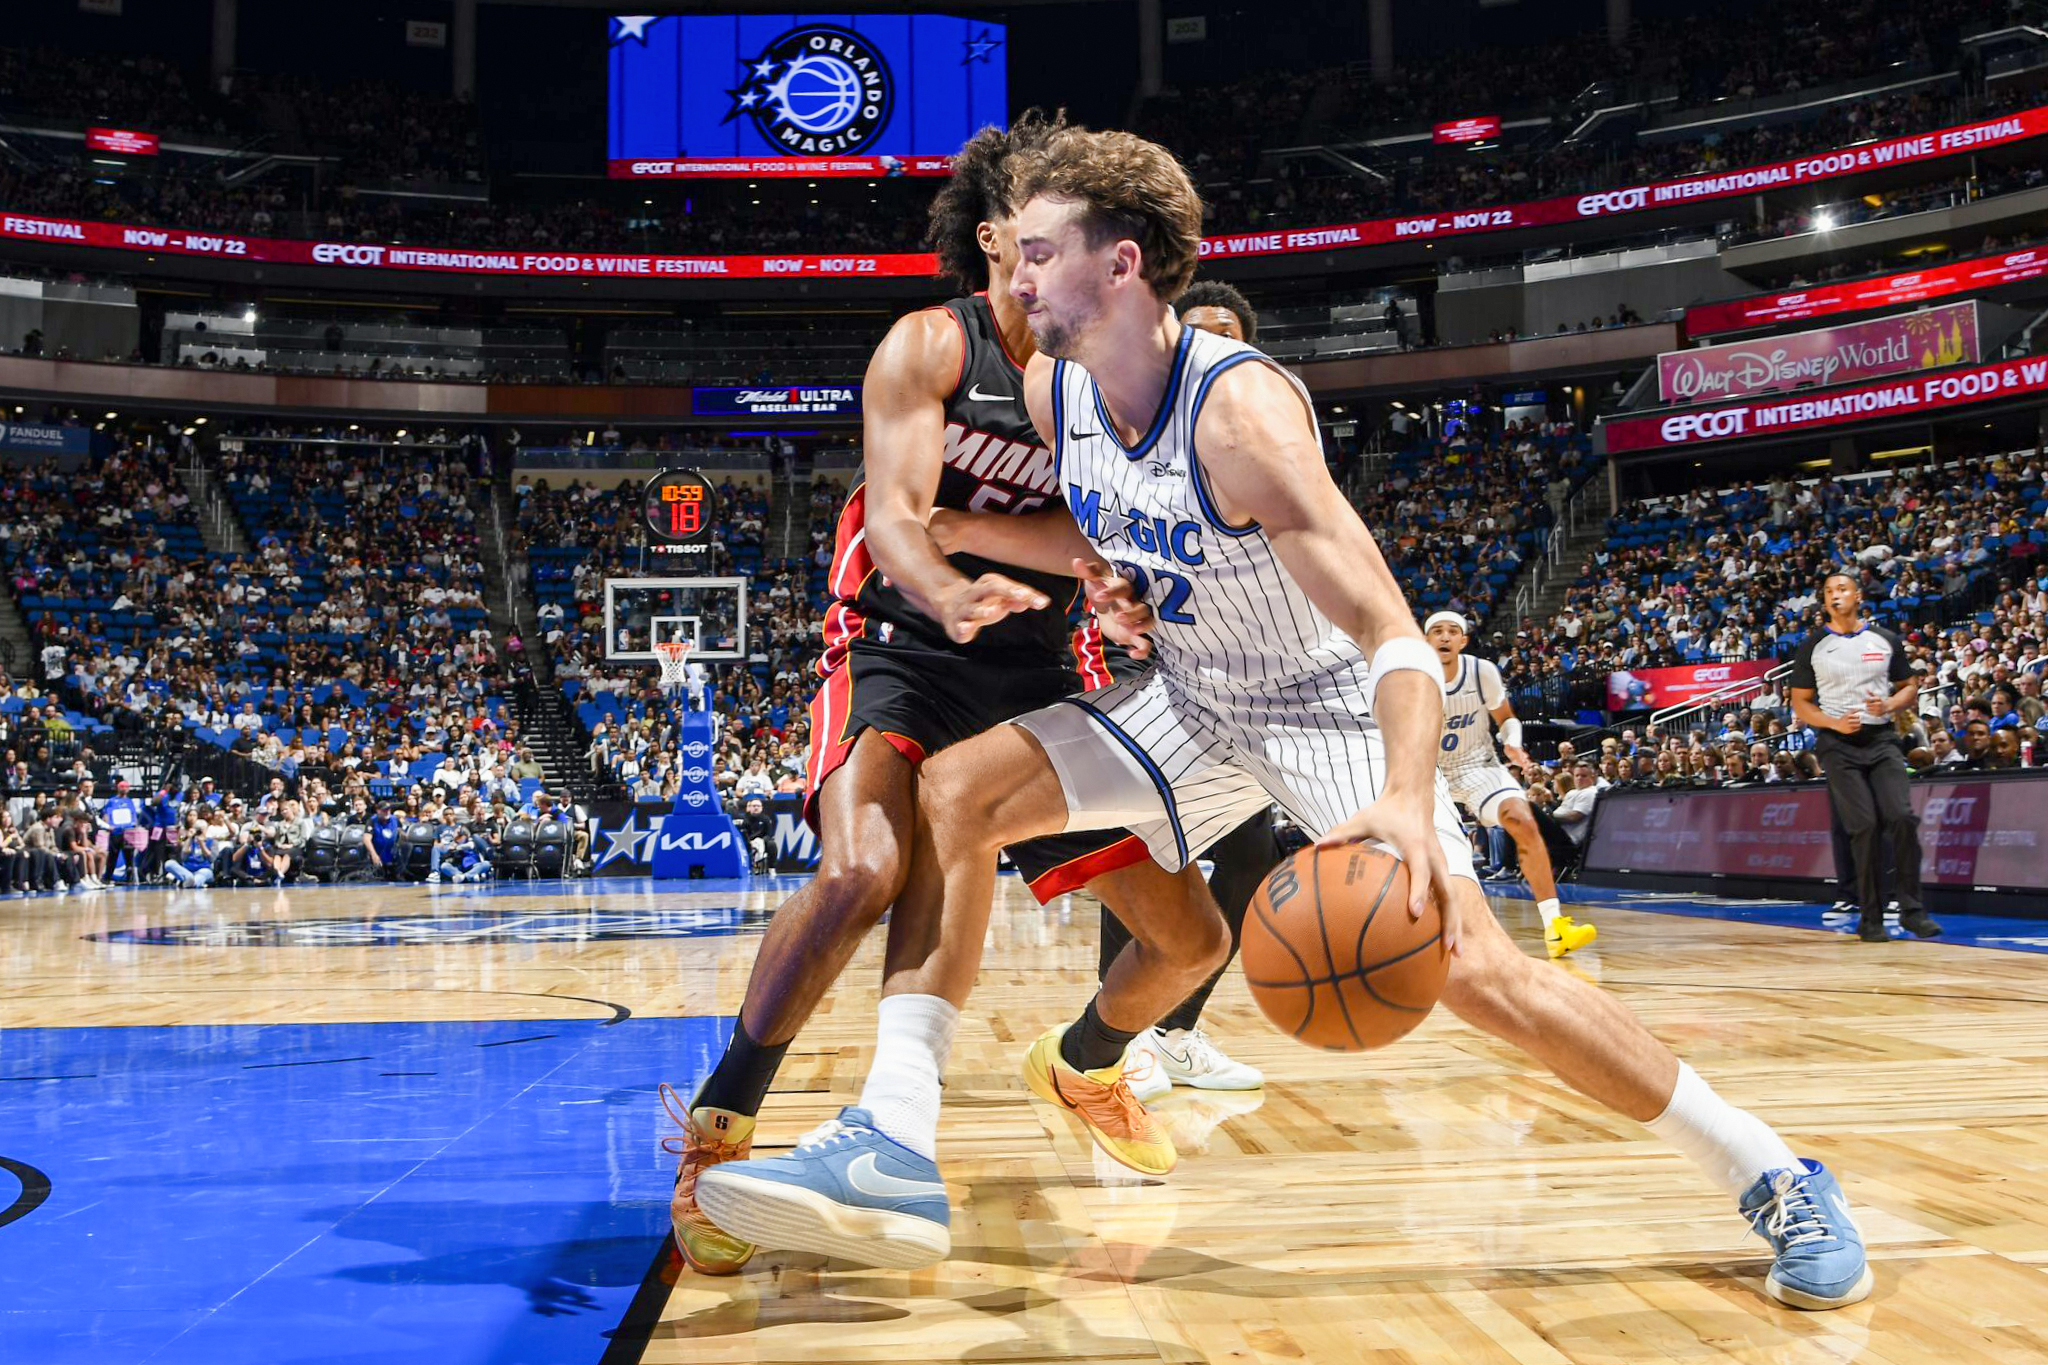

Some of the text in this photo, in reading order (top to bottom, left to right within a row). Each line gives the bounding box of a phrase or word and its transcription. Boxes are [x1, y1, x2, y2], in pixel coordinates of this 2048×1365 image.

[809, 36, 882, 120] ORLANDO
[780, 127, 862, 152] MAGIC
[632, 162, 674, 174] EPCOT
[752, 162, 787, 172] FOOD
[916, 161, 941, 171] NOW
[1577, 118, 2025, 216] EPCOT INTERNATIONAL FOOD & WINE FESTIVAL
[4, 217, 85, 239] FESTIVAL
[1396, 218, 1437, 236] NOW
[1453, 214, 1490, 230] NOV
[1492, 211, 1512, 224] 22
[123, 230, 168, 247] NOW
[185, 235, 223, 252] NOV
[225, 240, 246, 254] 22
[1213, 241, 1226, 253] &
[1227, 235, 1283, 253] WINE
[1287, 228, 1361, 247] FESTIVAL
[312, 243, 728, 274] EPCOT INTERNATIONAL FOOD & WINE FESTIVAL
[763, 259, 804, 273] NOW
[820, 258, 854, 272] NOV
[856, 259, 876, 272] 22
[1838, 334, 1910, 370] World
[751, 403, 837, 412] BASELINE BAR
[800, 390, 853, 402] ULTRA
[1661, 408, 1749, 442] EPCOT
[1755, 385, 1920, 427] INTERNATIONAL
[1925, 371, 1999, 402] FOOD
[2002, 369, 2019, 388] &
[10, 427, 63, 439] FANDUEL
[943, 421, 1062, 496] MIAM
[662, 485, 703, 501] 10:59
[671, 502, 699, 532] 18
[666, 544, 708, 554] TISSOT
